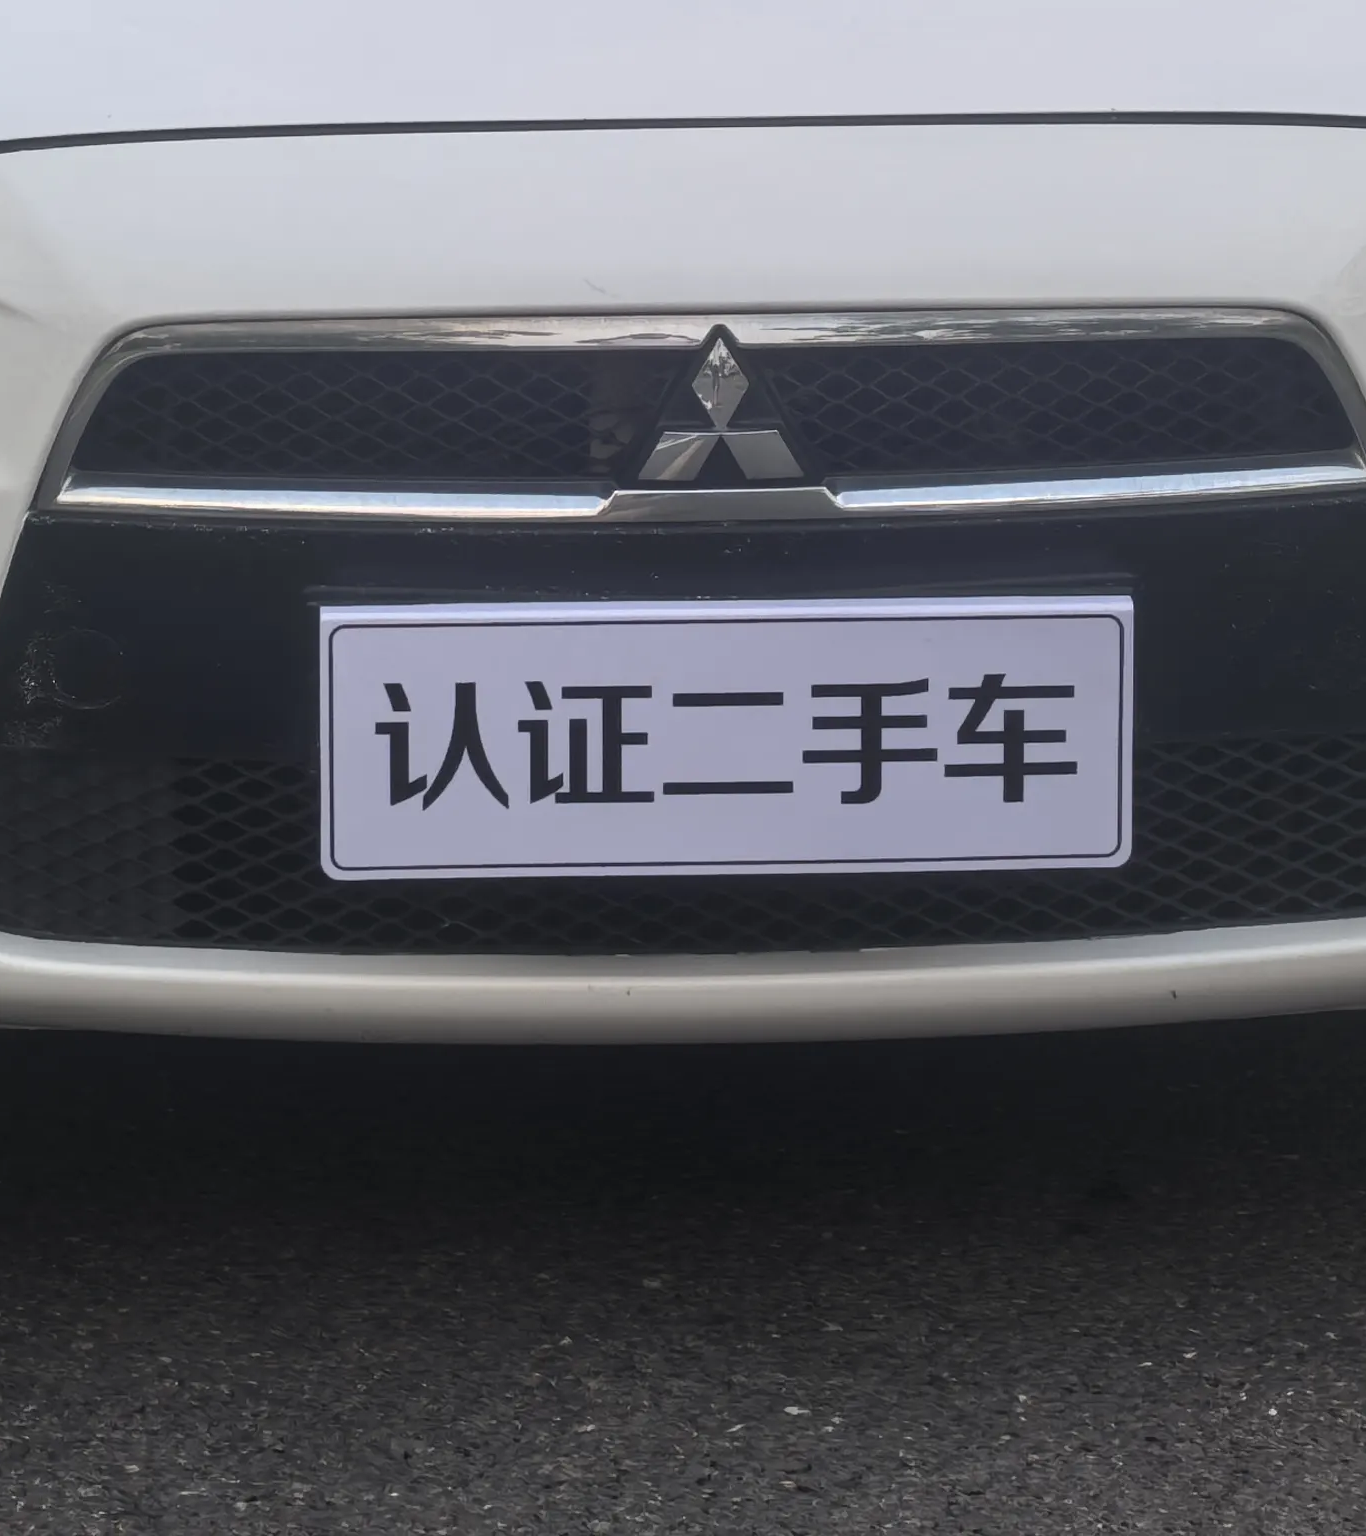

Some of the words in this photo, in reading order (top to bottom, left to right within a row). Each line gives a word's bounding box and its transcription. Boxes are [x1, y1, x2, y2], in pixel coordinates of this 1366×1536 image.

[375, 673, 1078, 811] 认证二手车
